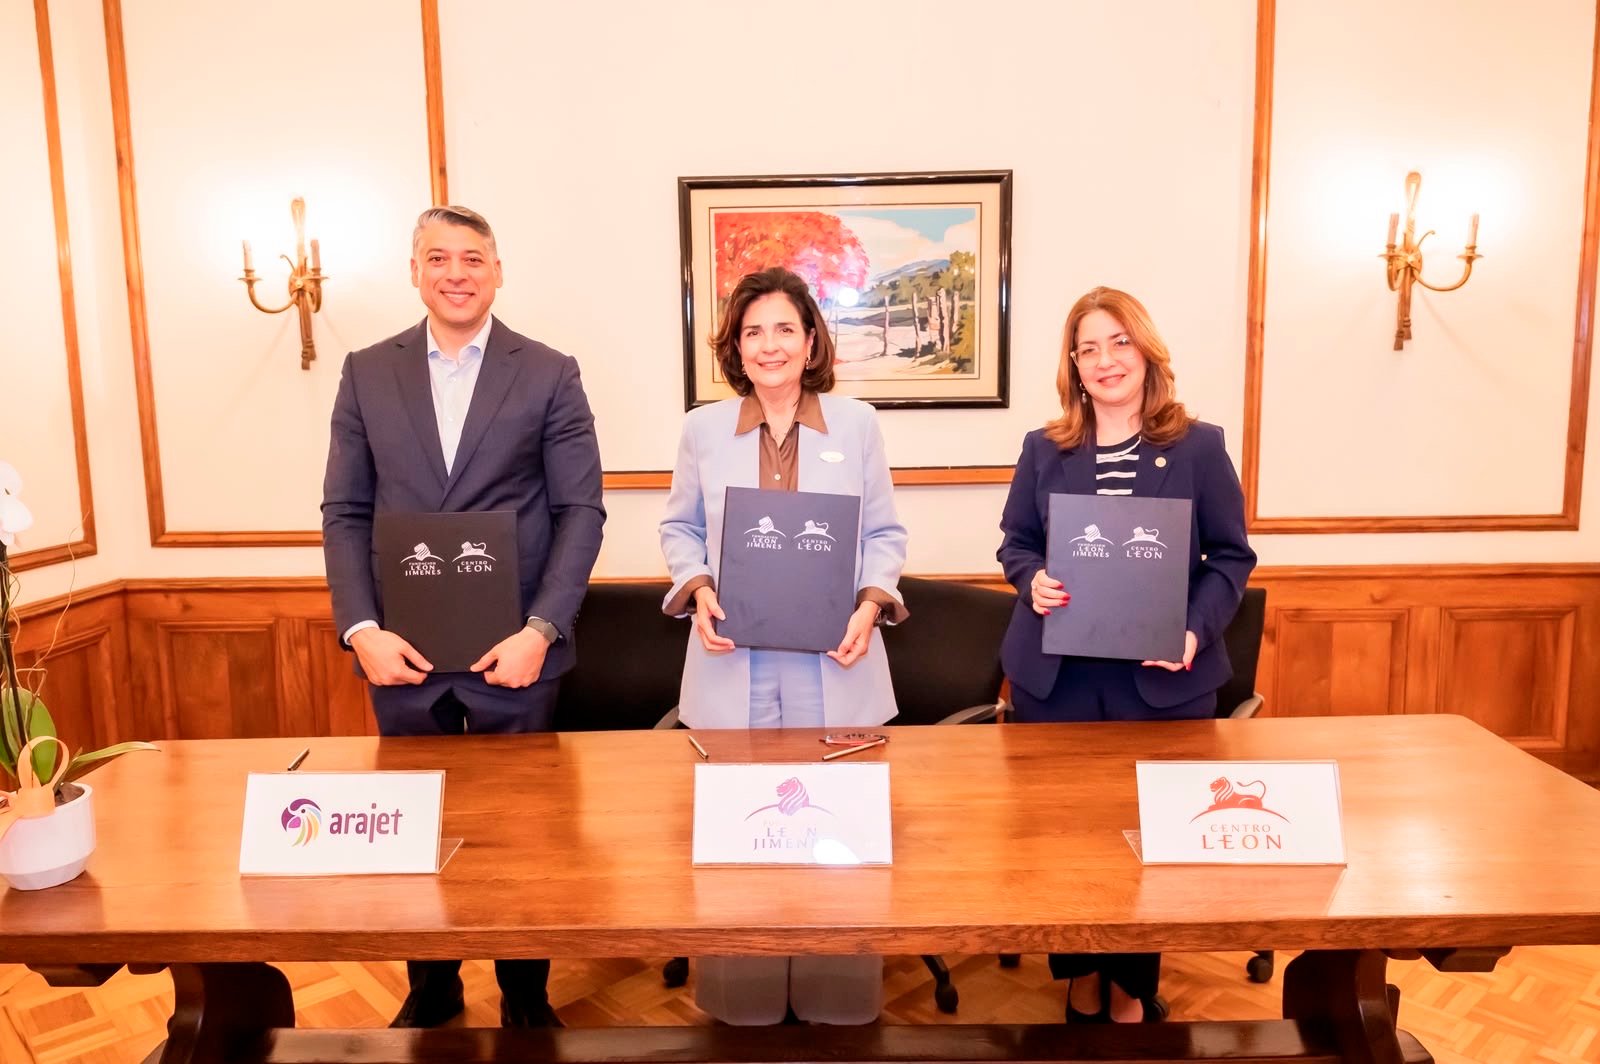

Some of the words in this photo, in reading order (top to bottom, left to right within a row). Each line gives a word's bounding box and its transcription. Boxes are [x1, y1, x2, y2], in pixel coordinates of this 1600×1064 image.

[797, 542, 832, 552] LEON
[1072, 550, 1110, 558] JIMENES
[1126, 550, 1162, 559] LEON
[457, 564, 492, 573] LEON
[329, 802, 403, 843] arajet
[767, 827, 817, 838] LEN
[1210, 824, 1271, 832] CENTRO
[1202, 834, 1282, 849] LEON
